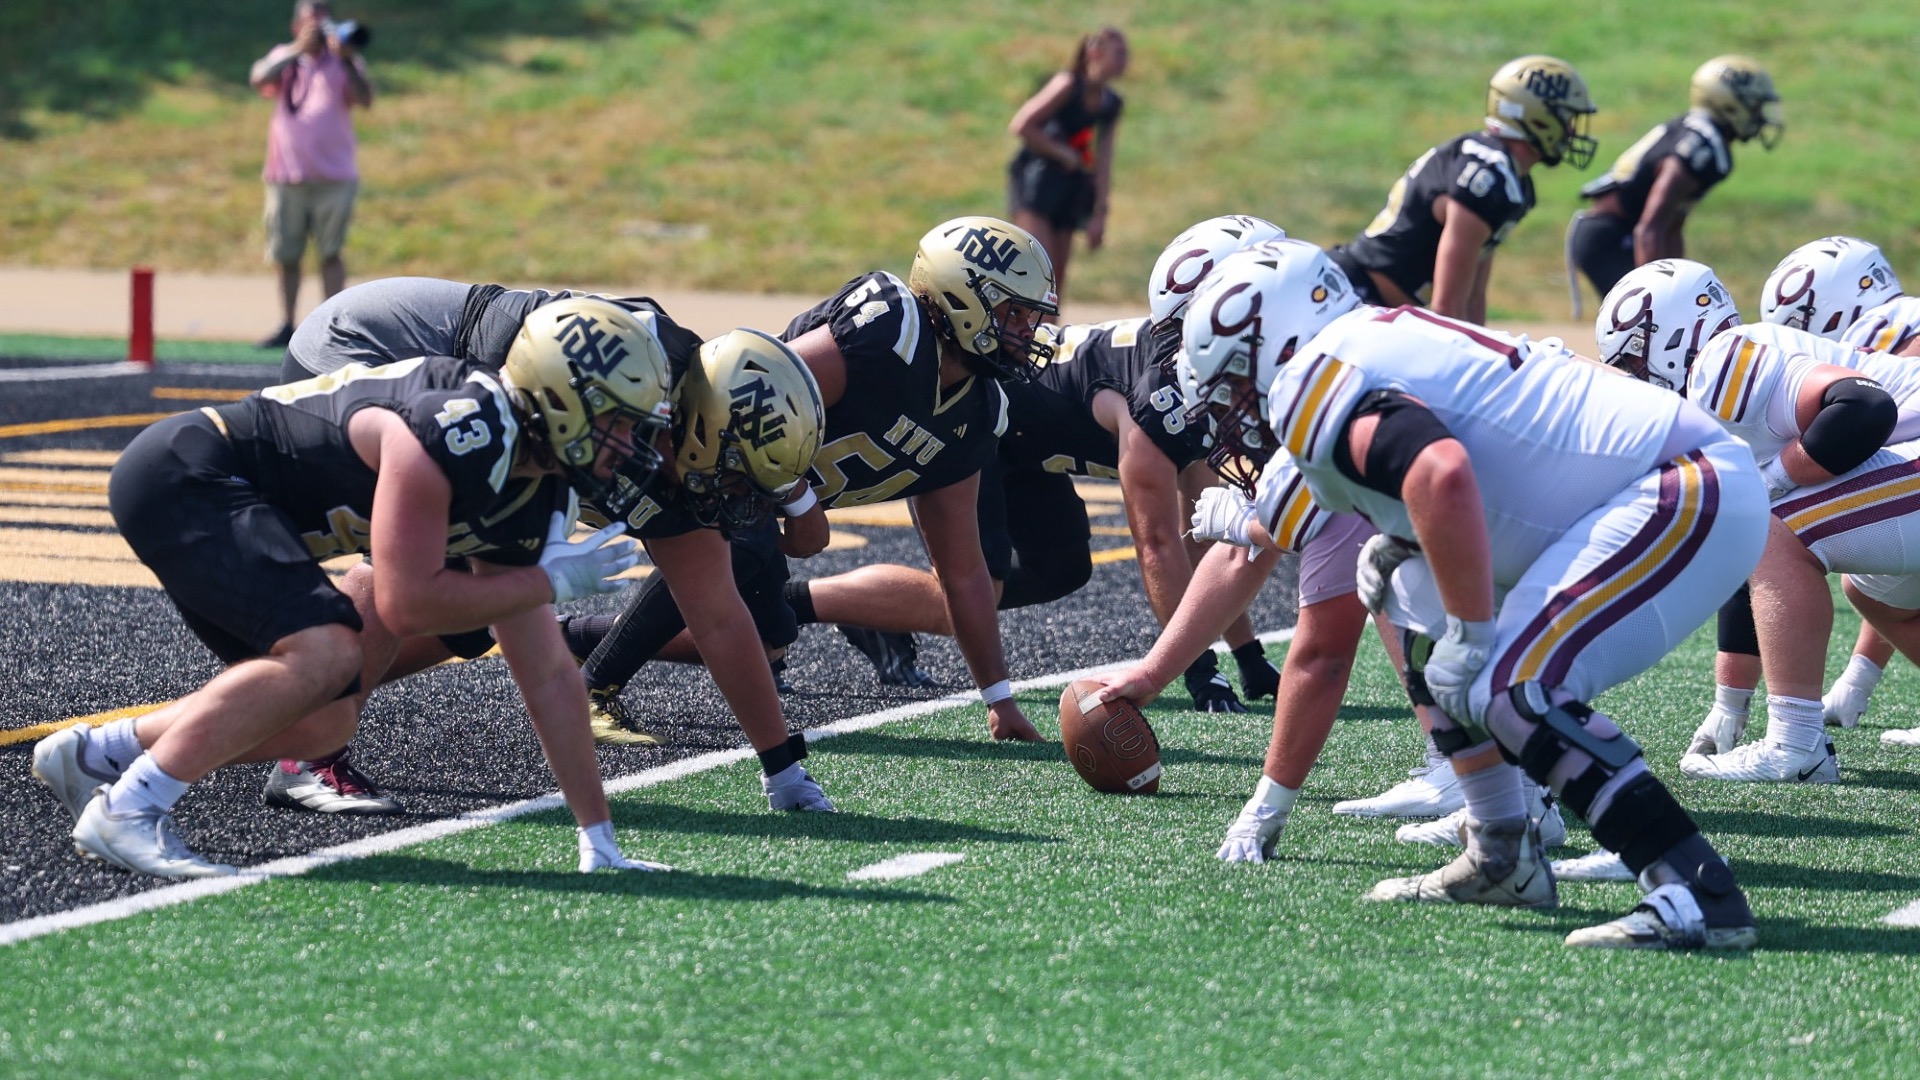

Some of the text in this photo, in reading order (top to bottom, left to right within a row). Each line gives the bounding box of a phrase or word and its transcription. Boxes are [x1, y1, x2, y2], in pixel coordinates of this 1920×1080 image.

[844, 277, 890, 329] 54
[434, 398, 492, 456] 43
[1150, 385, 1188, 435] 55
[883, 414, 946, 466] NWU
